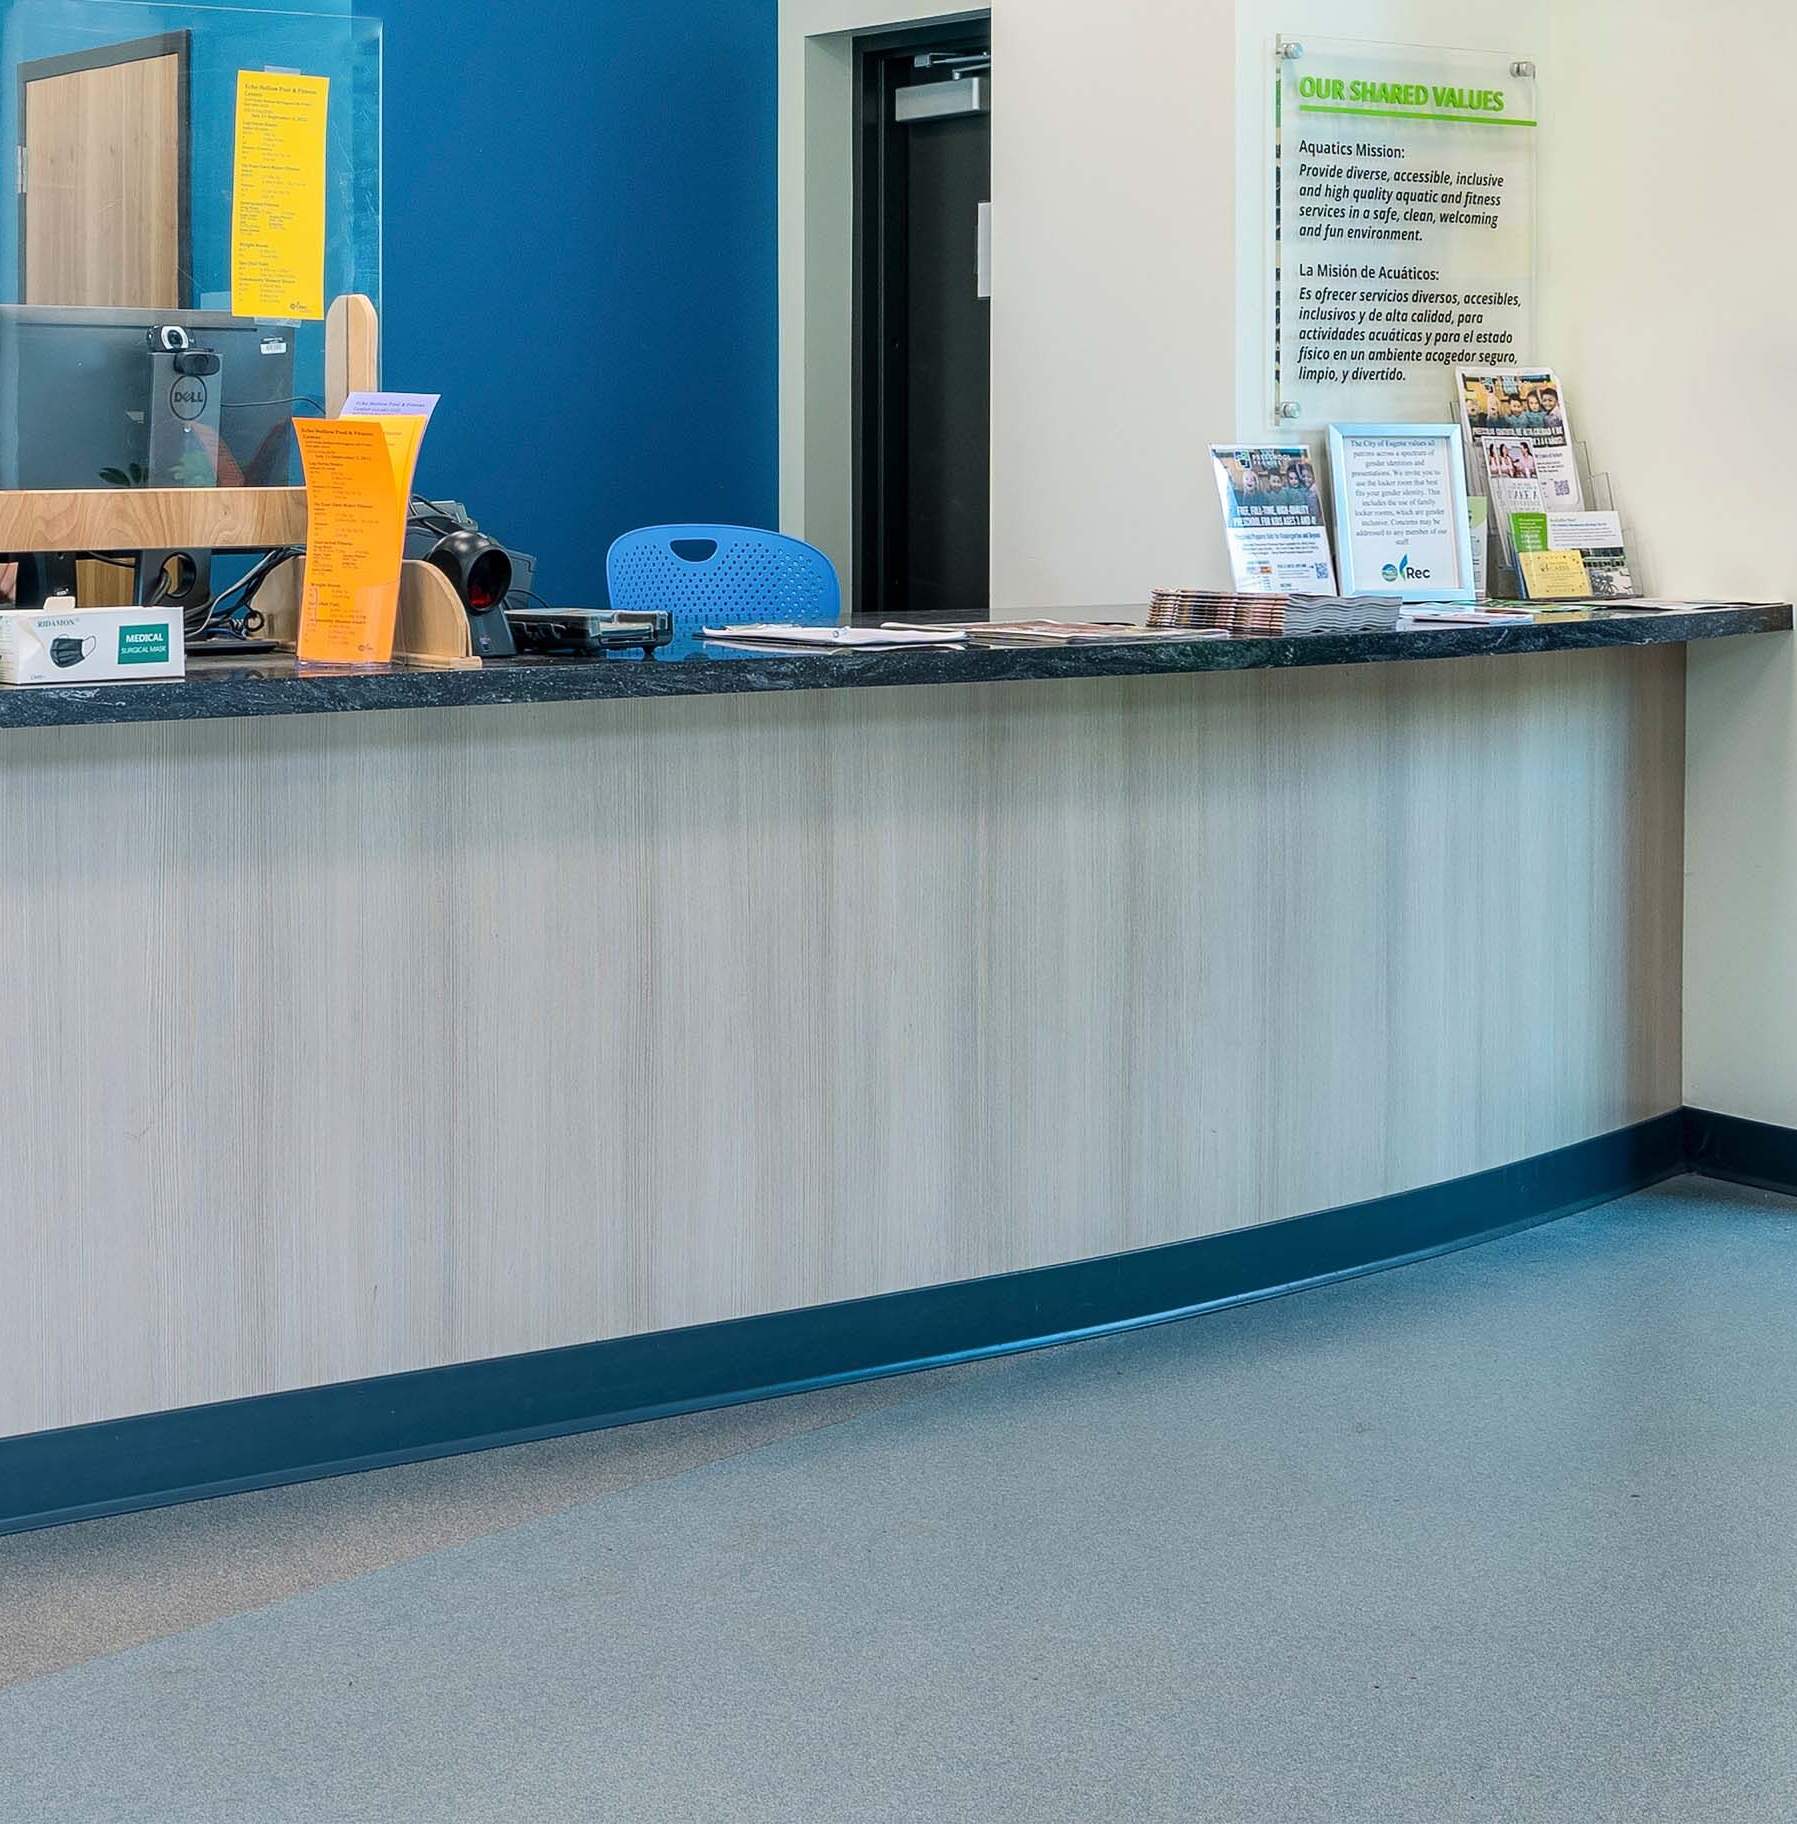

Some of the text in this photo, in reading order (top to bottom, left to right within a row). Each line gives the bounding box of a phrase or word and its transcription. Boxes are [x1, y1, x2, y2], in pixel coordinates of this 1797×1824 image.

[1298, 76, 1505, 112] OUR SHARED VALUES
[1298, 139, 1405, 159] Aquatics Mission:
[1299, 163, 1504, 188] Provide diverse, accessible, inclusive
[1299, 183, 1501, 209] and high quality aquatic and fitness
[1298, 203, 1499, 229] services in a safe, clean, welcoming
[1299, 223, 1423, 241] and fun environment.
[1299, 263, 1440, 281] La Misión de Acuáticos:
[1299, 286, 1521, 308] Es ofrecer servicios diversos, accesibles,
[1298, 306, 1484, 328] inclusivos y de alta calidad, para
[1298, 326, 1513, 347] actividades acuáticas y para el estado
[1296, 345, 1517, 367] físico en un ambiente acogedor seguro,
[1298, 366, 1406, 384] limpio, y divertido.
[174, 391, 203, 403] DELL
[1406, 567, 1431, 579] Rec
[125, 633, 164, 643] MEDICAL
[120, 645, 167, 654] SURGICAL MASK
